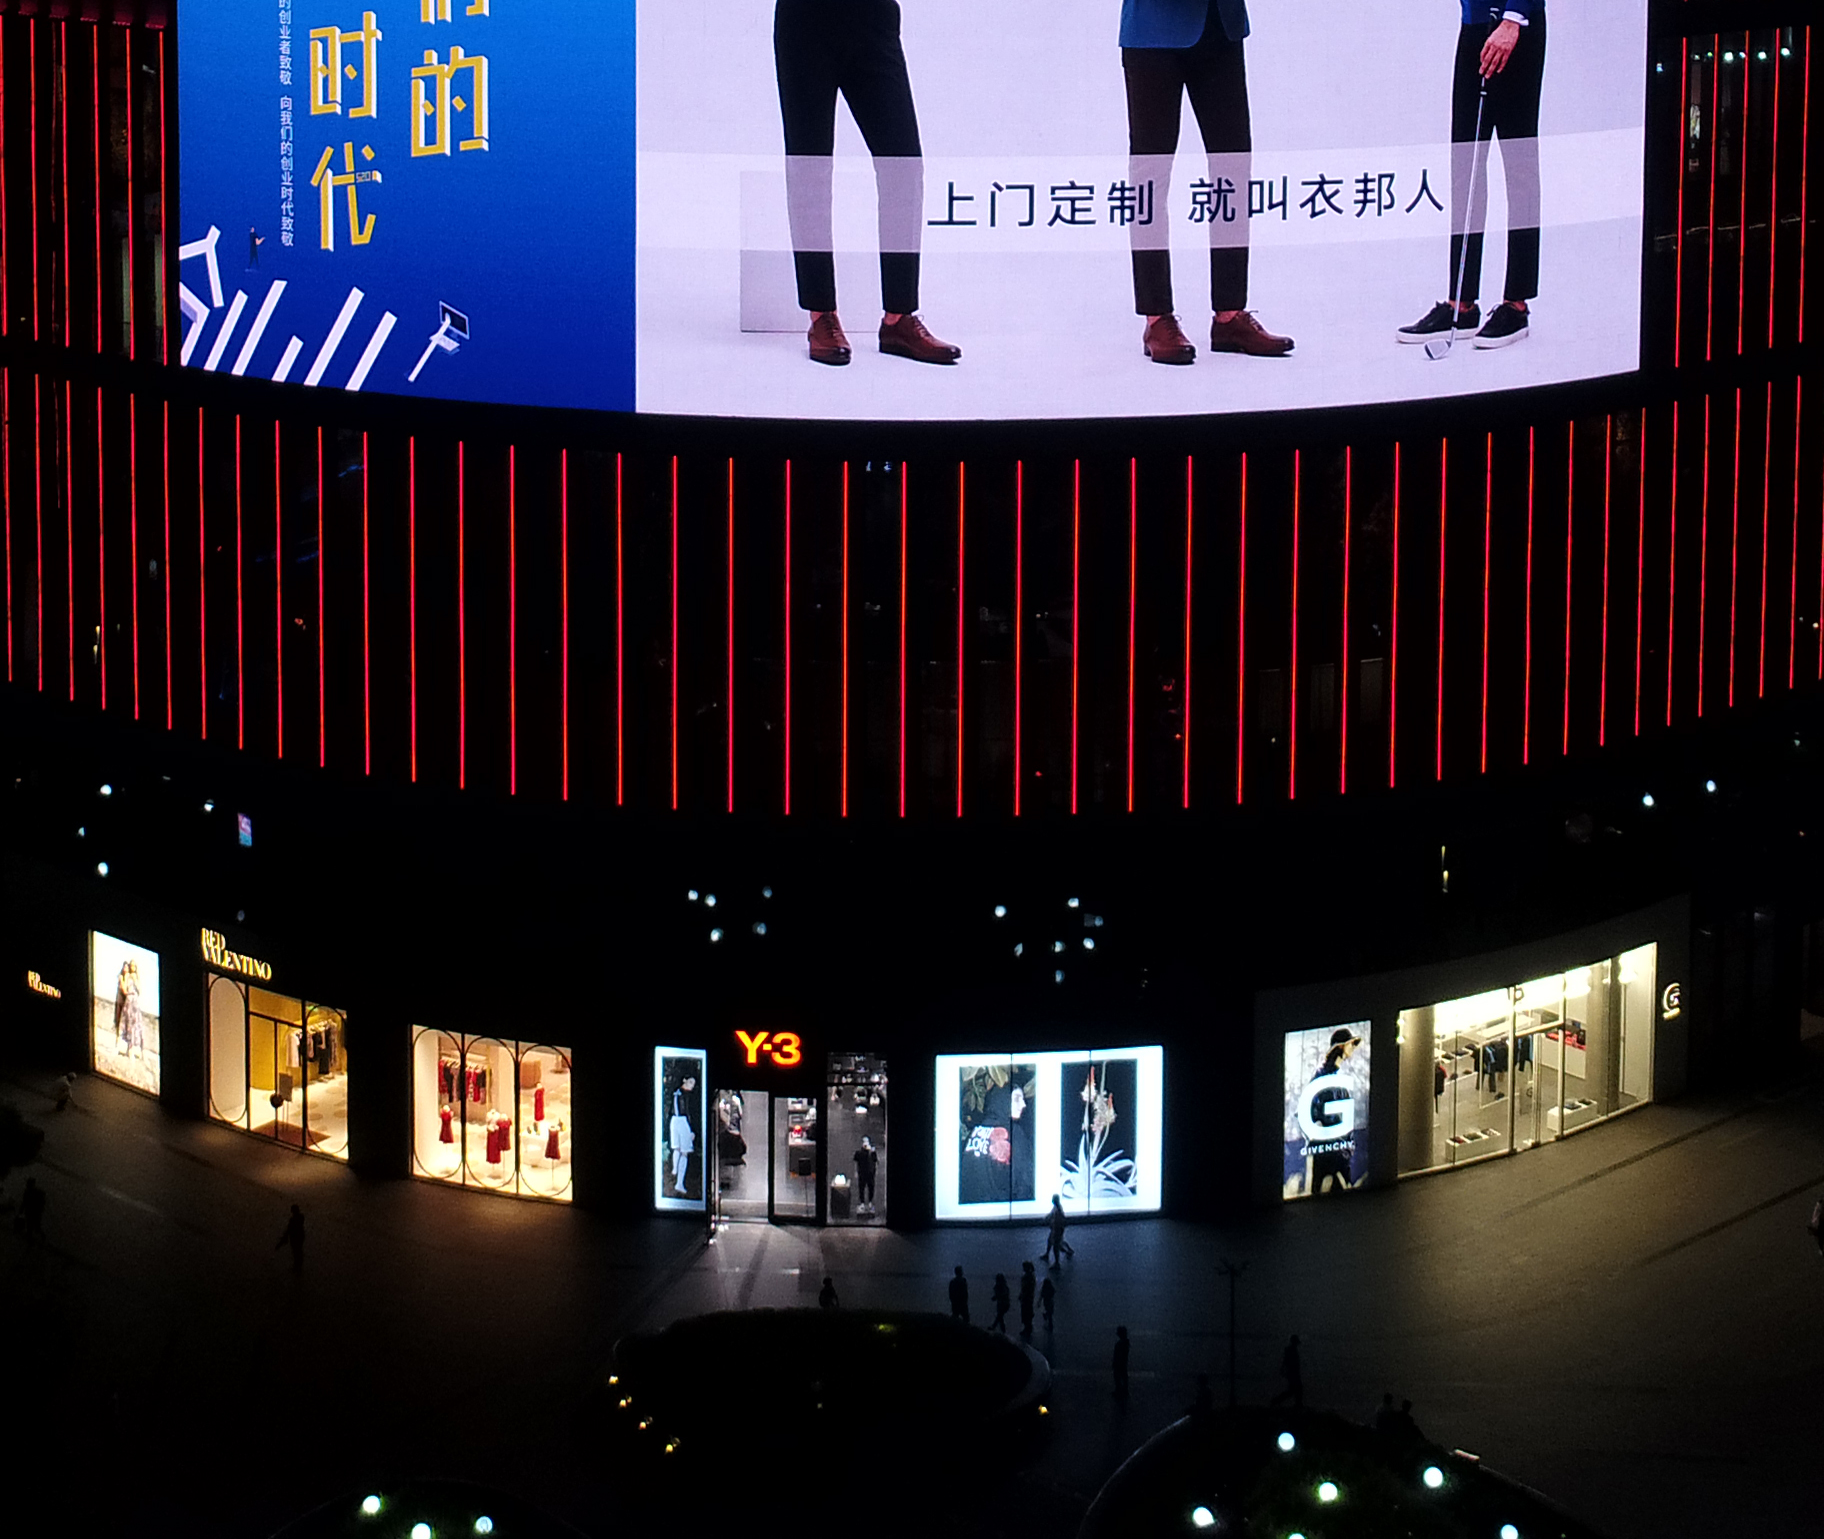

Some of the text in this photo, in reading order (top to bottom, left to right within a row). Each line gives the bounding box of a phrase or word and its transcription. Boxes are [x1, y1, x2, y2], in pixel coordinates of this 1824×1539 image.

[280, 95, 294, 247] 向我们的创业时代致敬
[927, 169, 1446, 228] 上门定制 就叫衣邦人
[201, 927, 226, 949] RED
[202, 946, 272, 981] VALENTINO
[735, 1030, 801, 1065] Y-3
[1297, 1073, 1354, 1141] G
